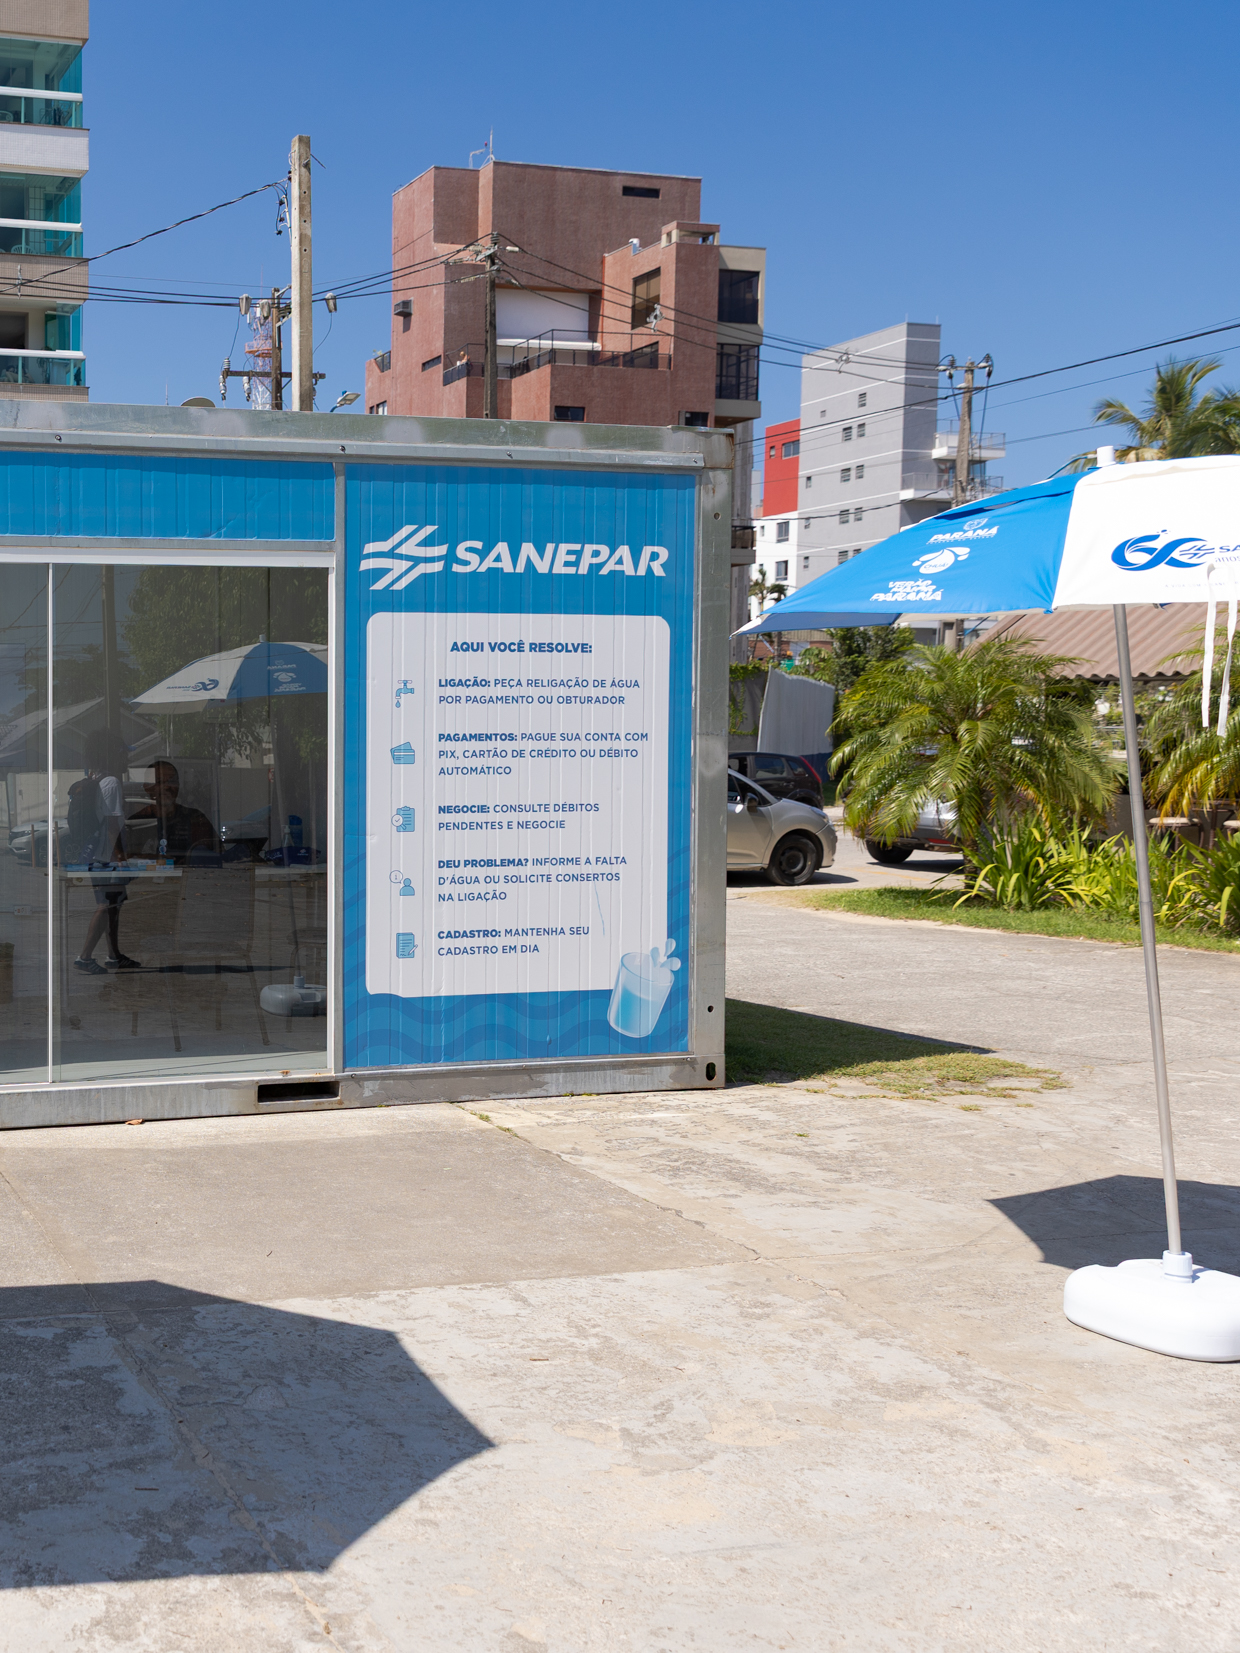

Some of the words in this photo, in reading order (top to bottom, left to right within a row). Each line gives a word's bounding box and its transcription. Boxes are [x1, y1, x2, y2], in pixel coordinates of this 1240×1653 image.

[451, 540, 669, 577] SANEPAR
[449, 640, 485, 653] AQUI
[487, 639, 526, 653] VOCÊ
[528, 641, 593, 654] RESOLVE:
[438, 675, 491, 691] LIGAÇÃO:
[493, 678, 523, 691] PEÇA
[526, 676, 589, 691] RELIGAÇÃO
[592, 679, 607, 689] DE
[609, 677, 640, 689] ÁGUA
[438, 695, 462, 704] POR
[465, 695, 535, 705] PAGAMENTO
[537, 695, 554, 705] OU
[556, 695, 626, 705] OBTURADOR
[437, 732, 518, 743] PAGAMENTOS:
[520, 732, 557, 742] PAGUE
[559, 732, 581, 742] SUA
[584, 732, 622, 742] CONTA
[624, 732, 648, 742] COM
[438, 750, 460, 761] PIX,
[462, 747, 508, 759] CARTÃO
[511, 748, 526, 759] DE
[529, 747, 577, 759] CRÉDITO
[579, 748, 596, 758] OU
[598, 747, 639, 758] DÉBITO
[438, 765, 512, 776] AUTOMÁTICO
[438, 804, 490, 815] NEGOCIE:
[493, 803, 550, 814] CONSULTE
[553, 803, 600, 813] DÉBITOS
[438, 821, 504, 832] PENDENTES
[506, 820, 513, 830] E
[516, 819, 565, 830] NEGOCIE
[438, 859, 461, 869] DEU
[463, 857, 530, 868] PROBLEMA?
[532, 857, 581, 867] INFORME
[583, 856, 592, 866] A
[595, 856, 627, 866] FALTA
[438, 874, 480, 886] D'ÁGUA
[483, 874, 500, 884] OU
[503, 873, 552, 884] SOLICITE
[555, 872, 621, 883] CONSERTOS
[438, 893, 455, 902] NA
[457, 889, 507, 904] LIGAÇÃO
[437, 928, 502, 940] CADASTRO:
[504, 927, 566, 937] MANTENHA
[568, 926, 590, 936] SEU
[437, 945, 499, 956] CADASTRO
[501, 944, 518, 954] EM
[520, 944, 540, 953] DIA
